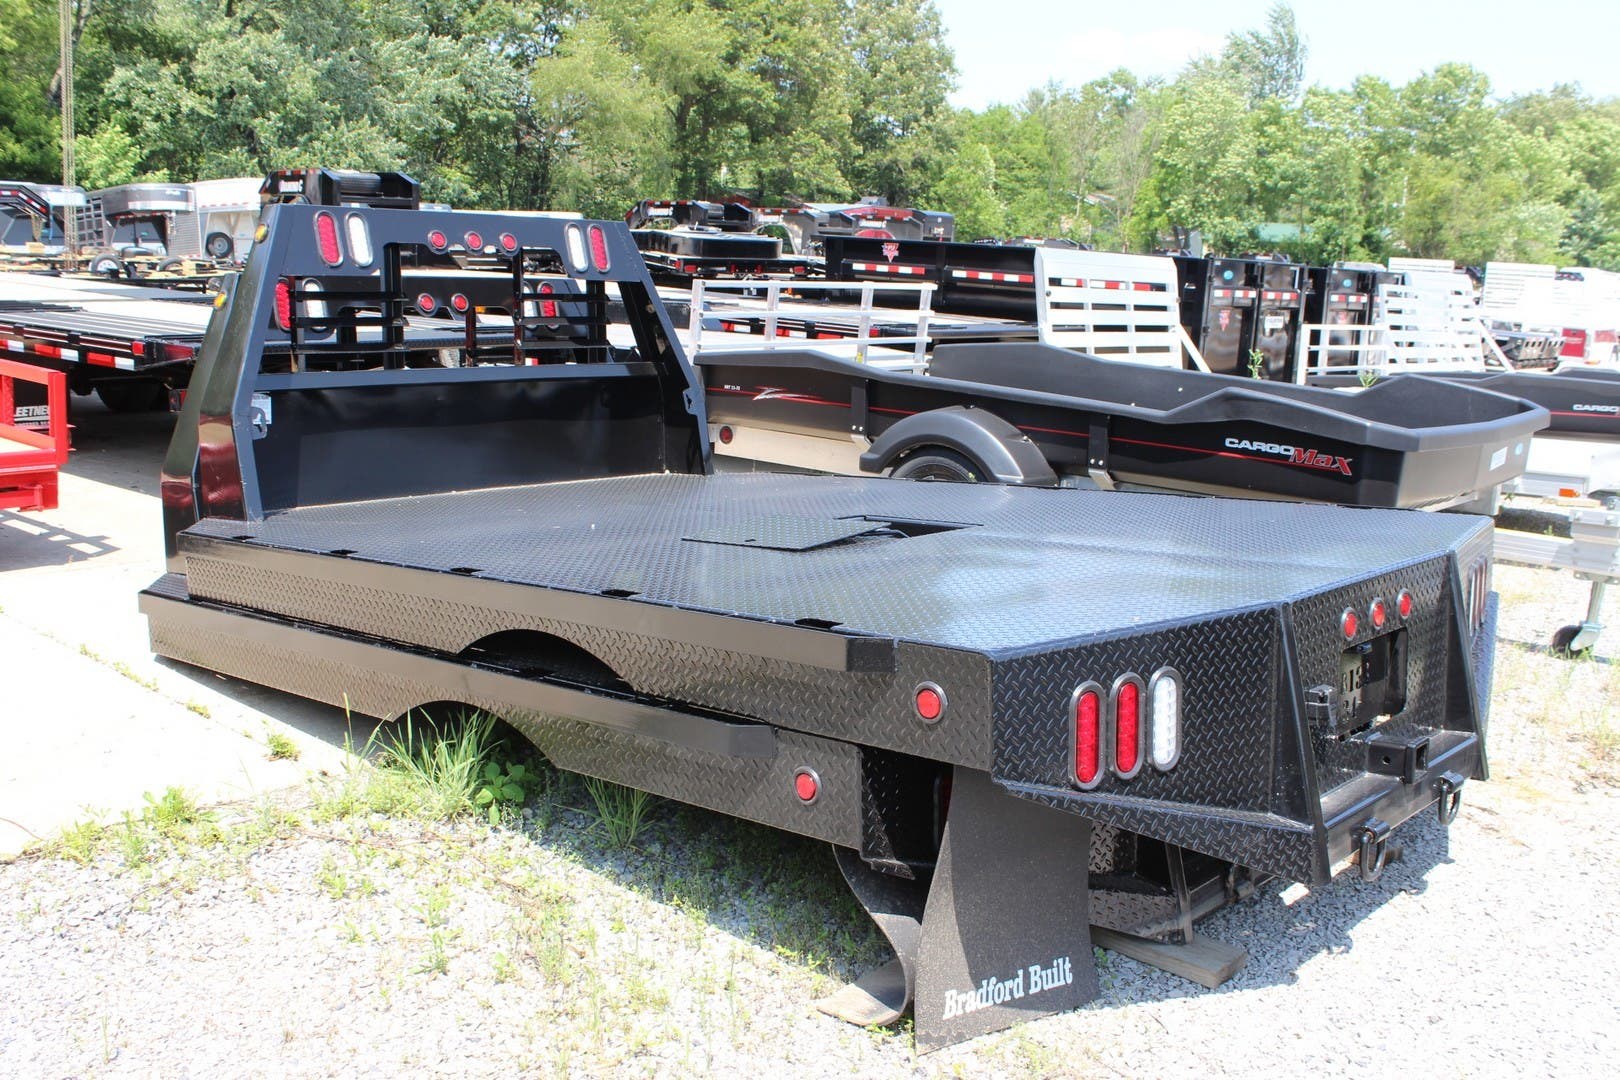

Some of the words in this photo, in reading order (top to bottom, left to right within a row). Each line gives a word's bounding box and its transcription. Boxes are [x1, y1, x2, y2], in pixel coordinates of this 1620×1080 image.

[1572, 404, 1620, 416] CARGO
[942, 968, 1024, 1021] Bradford
[1028, 956, 1073, 995] Built
